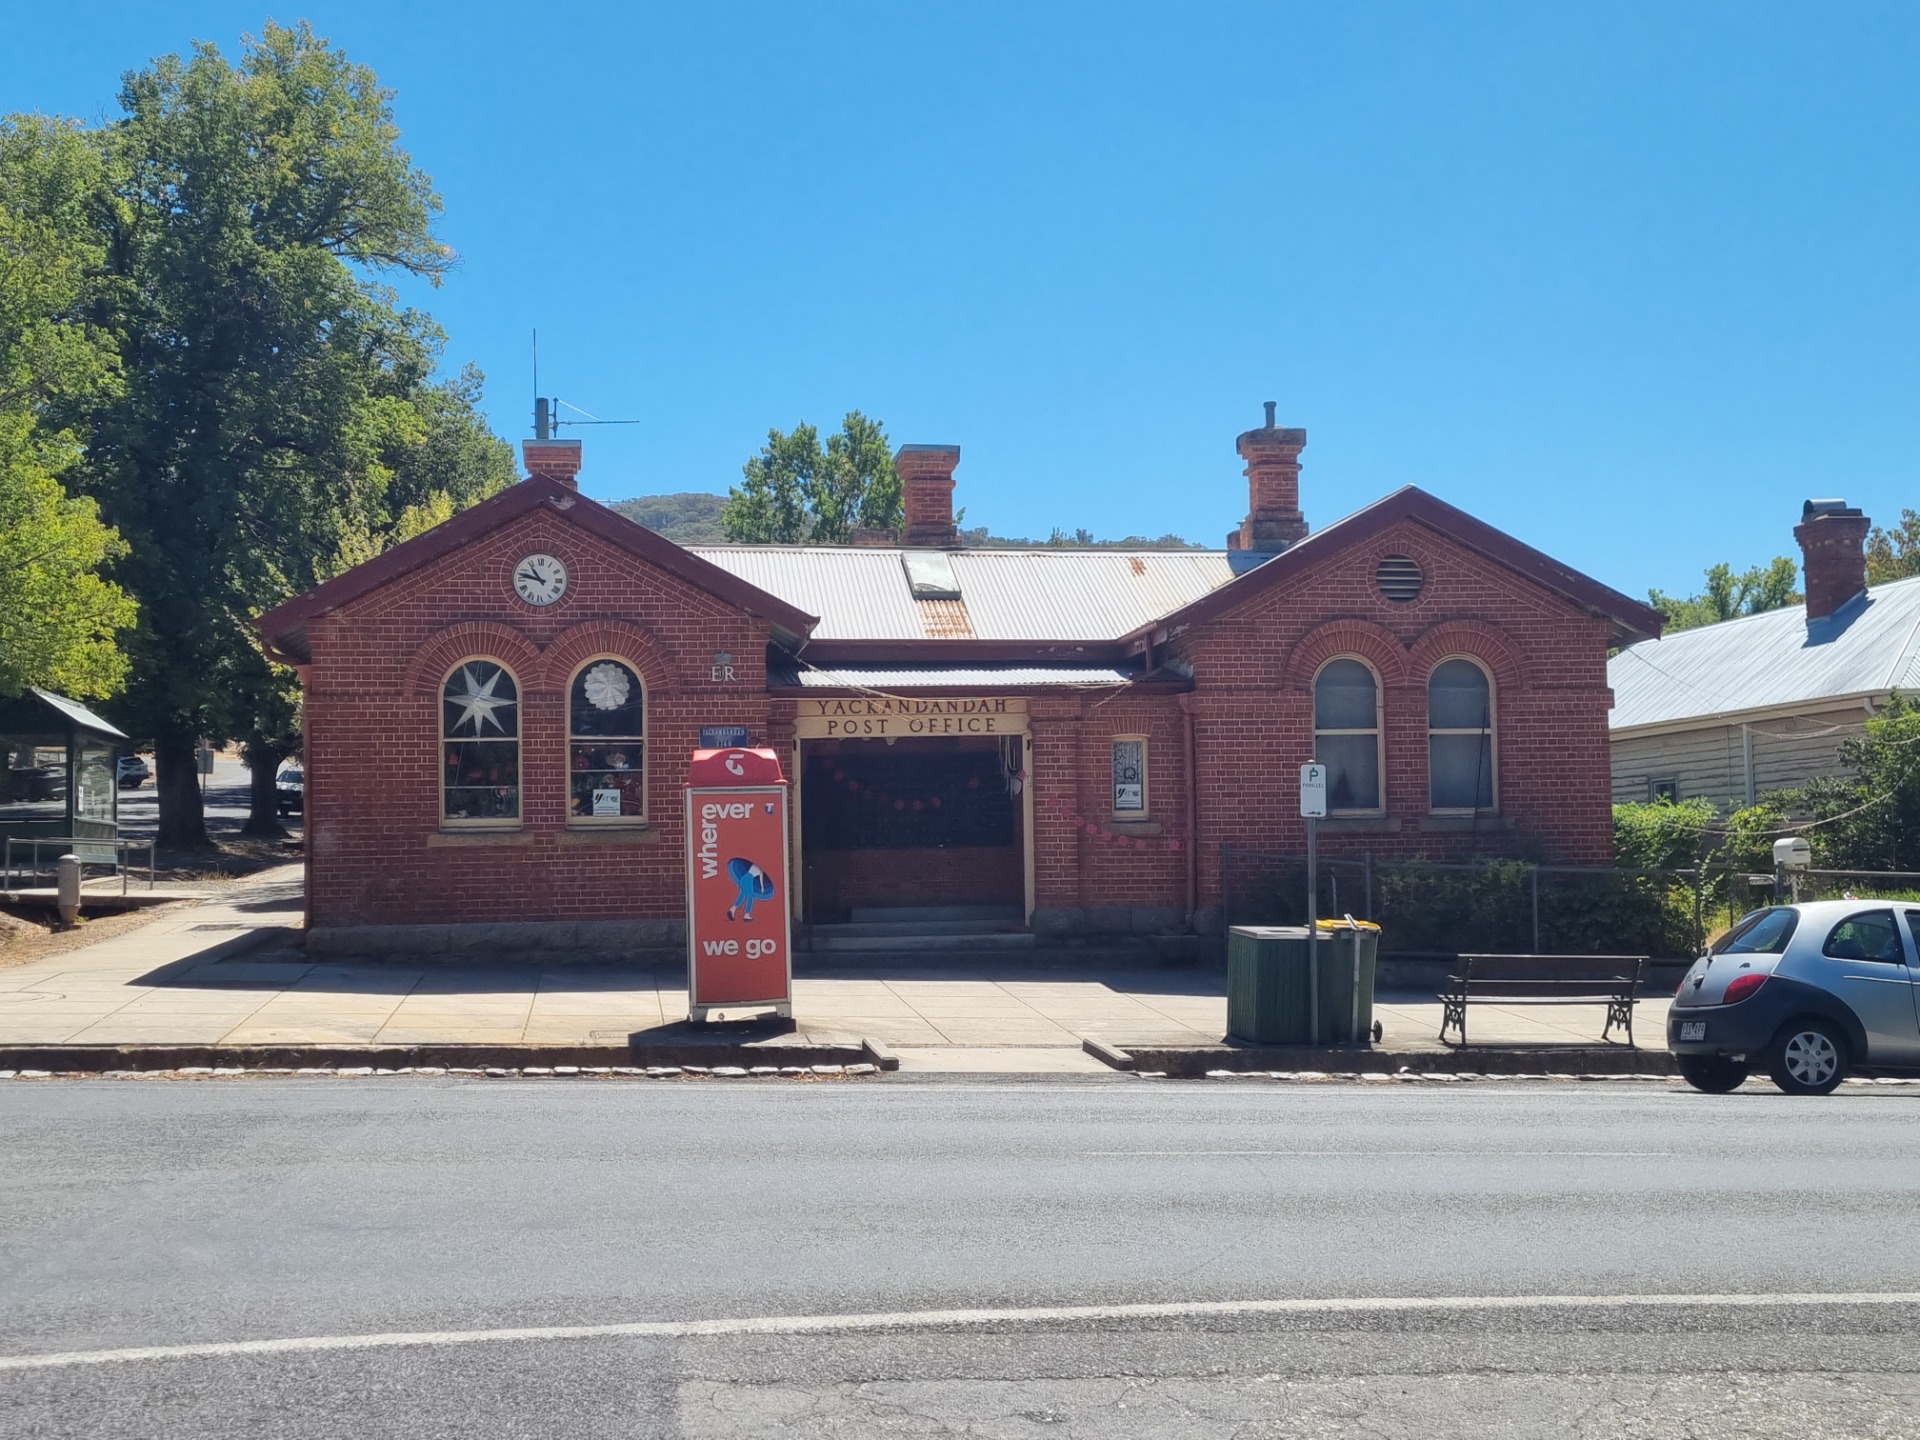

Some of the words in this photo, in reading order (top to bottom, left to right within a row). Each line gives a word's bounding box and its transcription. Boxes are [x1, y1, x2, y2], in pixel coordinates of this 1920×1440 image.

[817, 700, 1007, 715] YACKANDANDAH
[827, 719, 889, 735] POST
[909, 717, 996, 733] OFFICE
[702, 940, 739, 956] we
[745, 938, 777, 960] go
